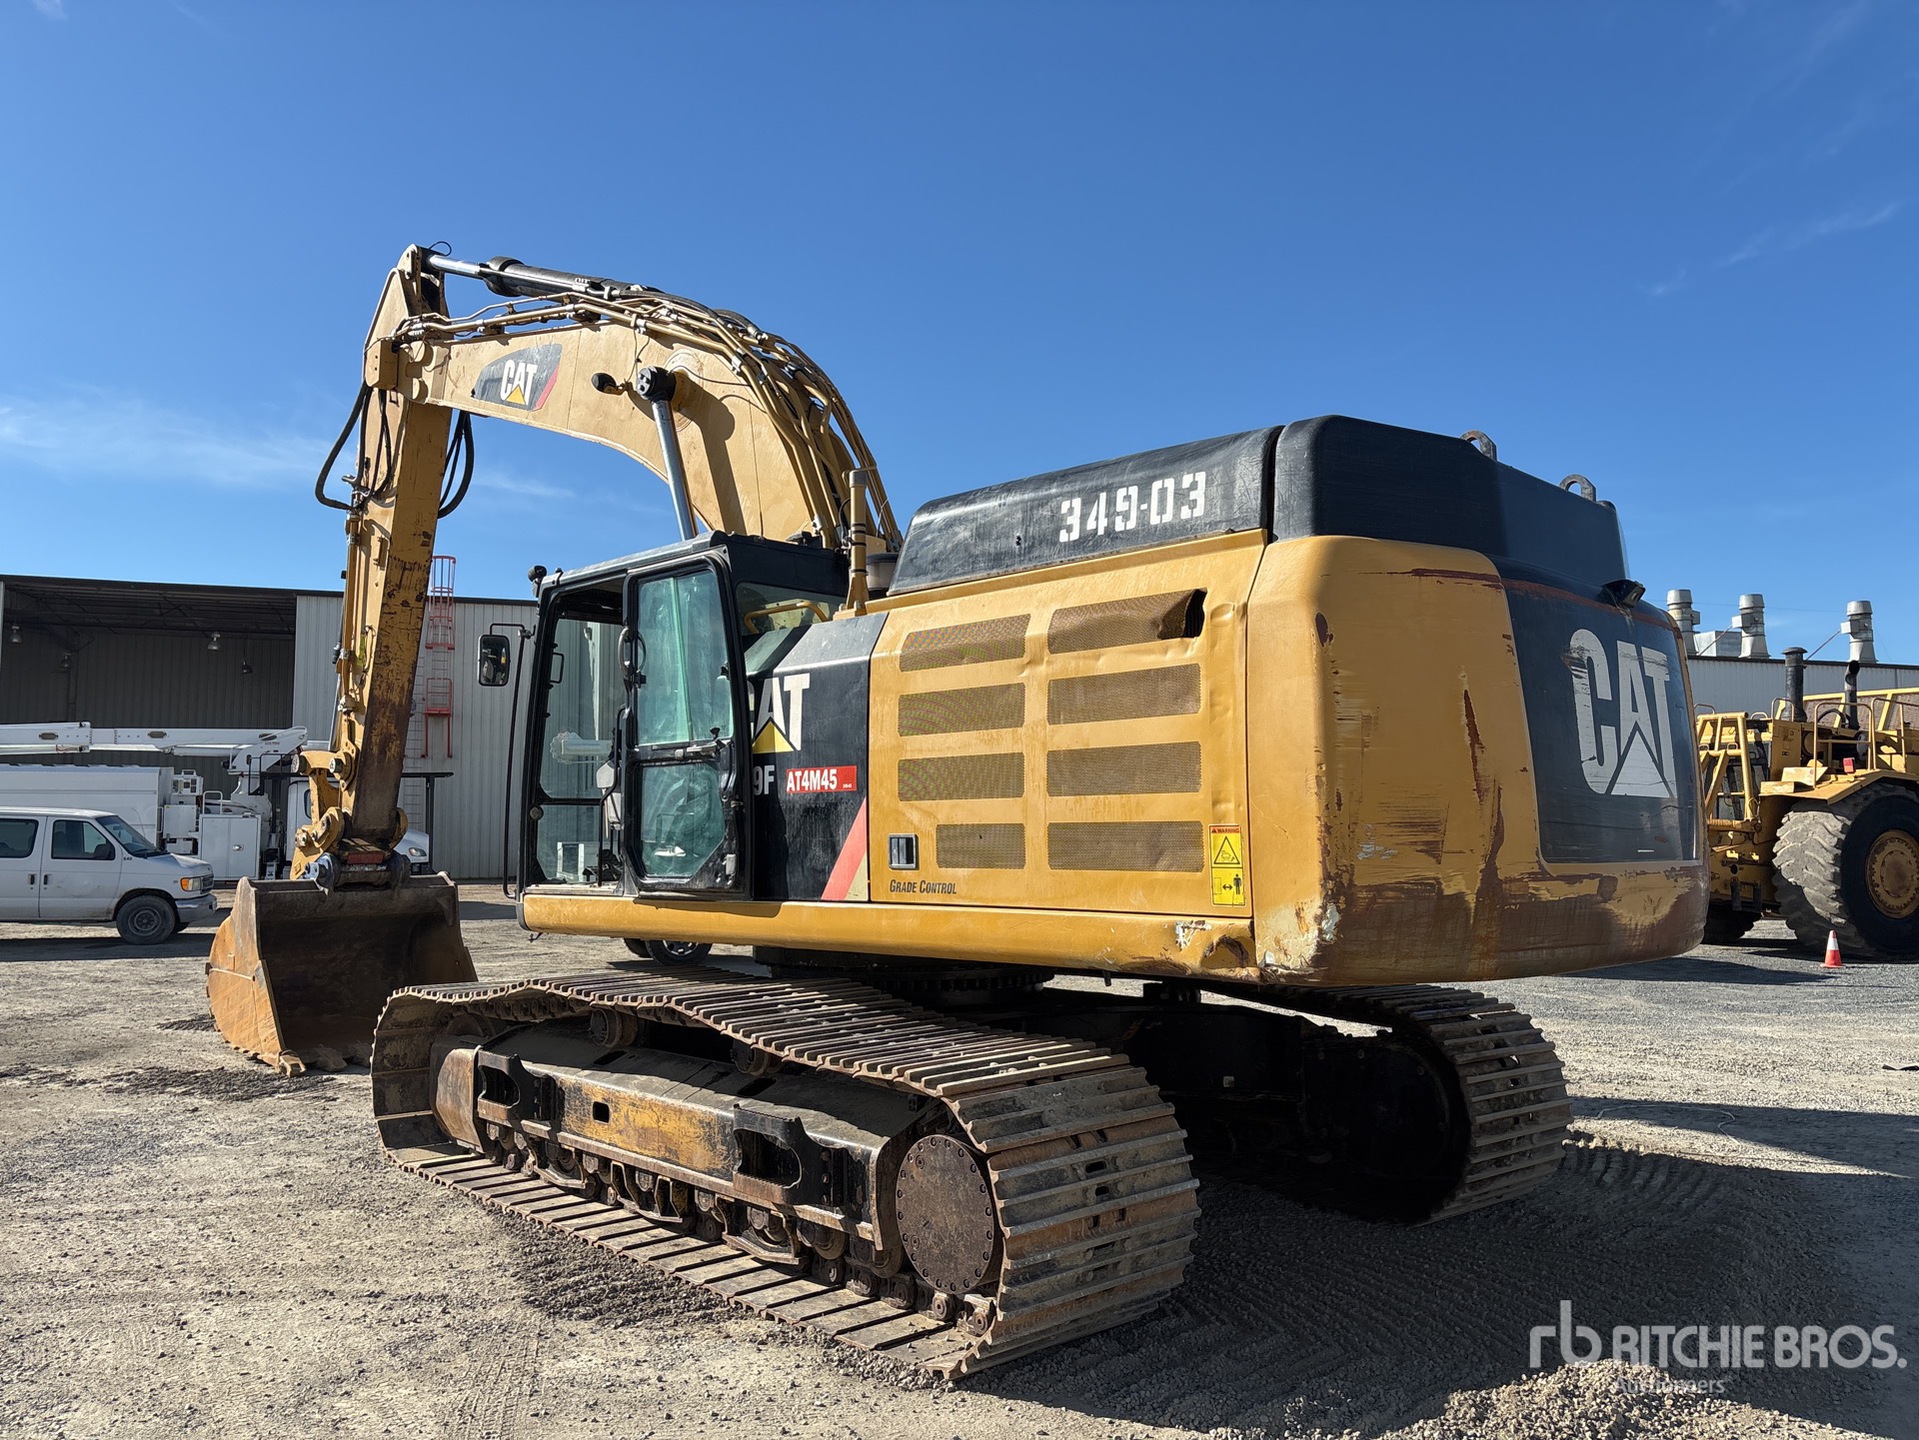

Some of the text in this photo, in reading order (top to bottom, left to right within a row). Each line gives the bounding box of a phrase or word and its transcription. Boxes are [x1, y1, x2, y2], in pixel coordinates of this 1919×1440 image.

[500, 359, 538, 405] CAT
[1059, 471, 1206, 542] 349-03
[748, 673, 811, 750] AT
[1569, 629, 1677, 798] CAT
[786, 768, 838, 792] AT4M45
